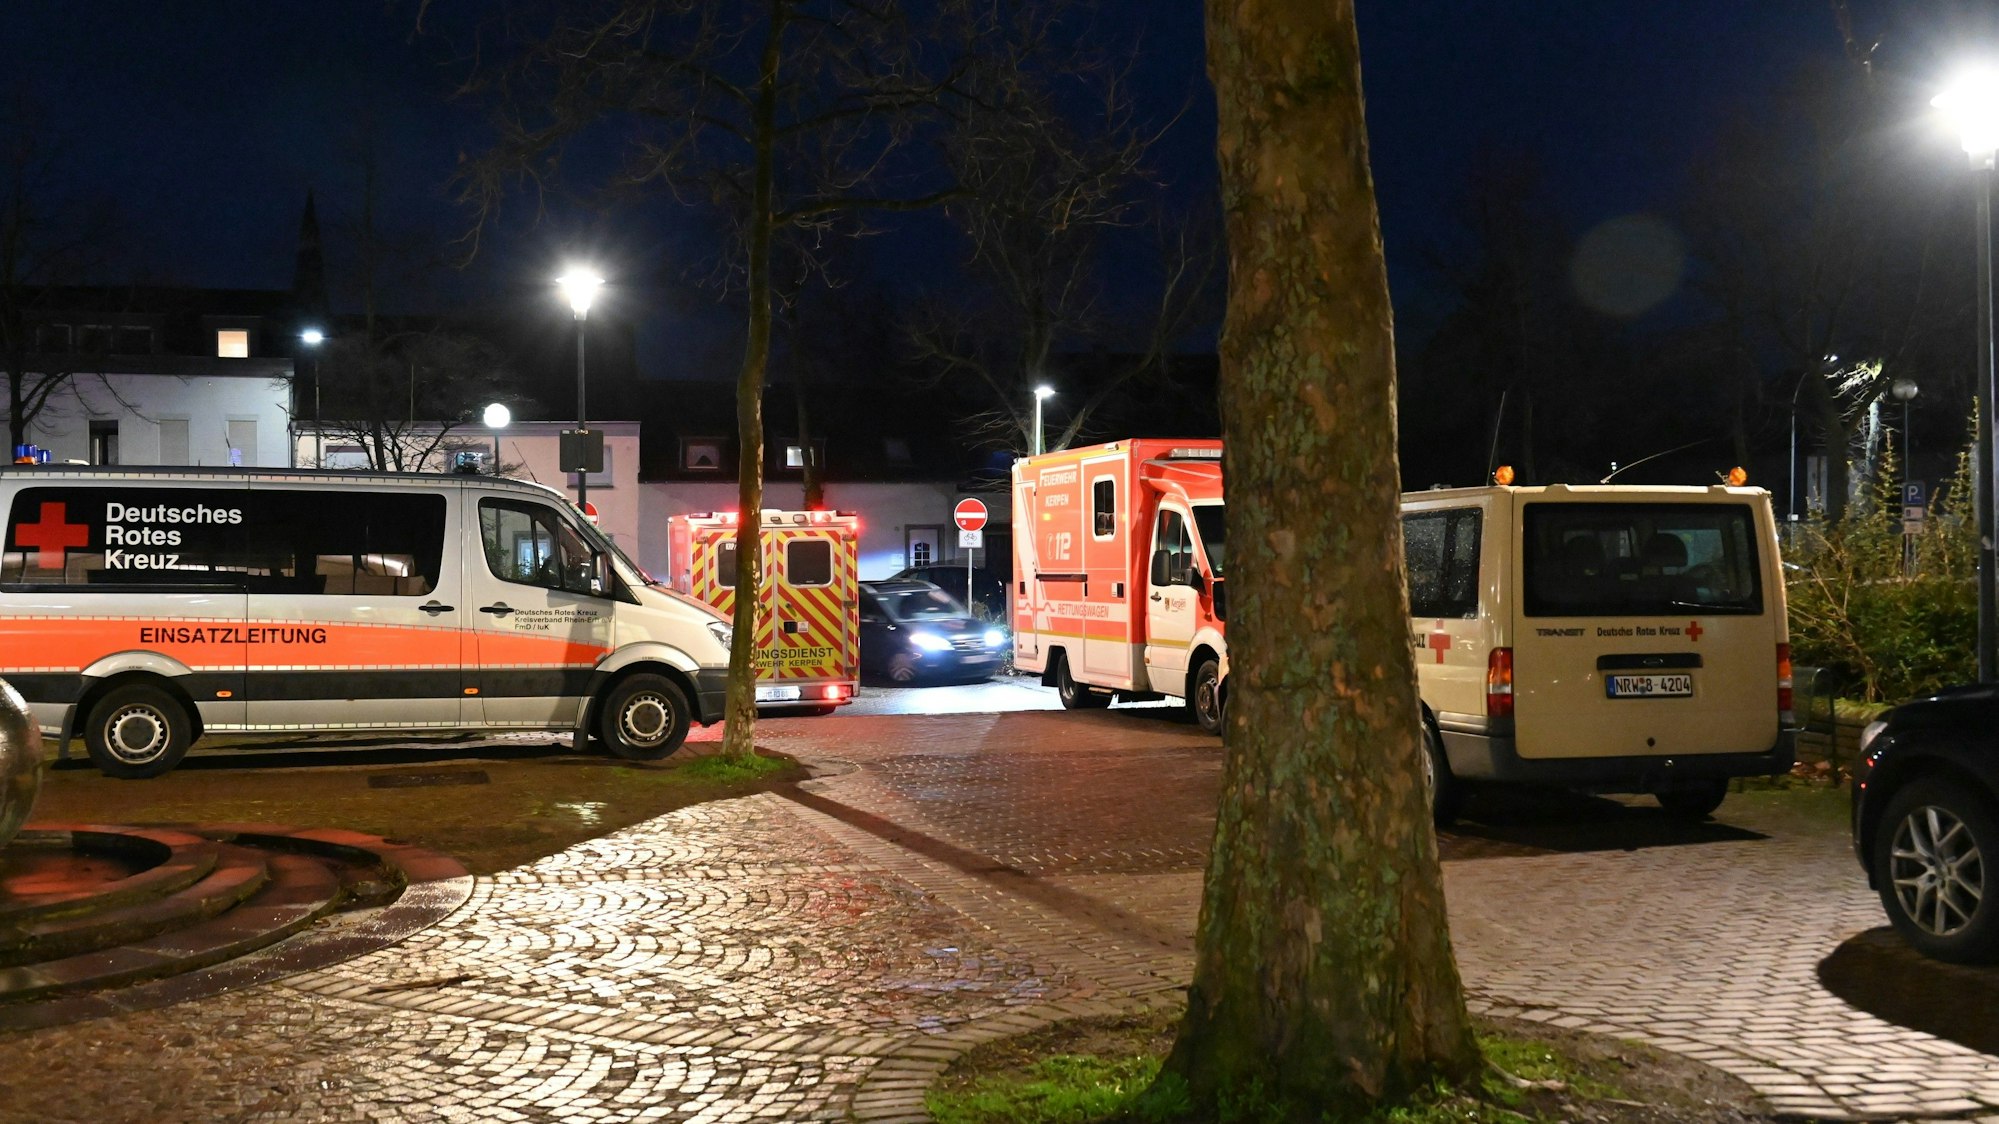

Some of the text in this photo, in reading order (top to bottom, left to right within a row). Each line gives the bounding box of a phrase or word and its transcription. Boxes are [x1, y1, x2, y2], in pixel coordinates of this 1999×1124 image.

[1045, 493, 1069, 507] KERPEN
[106, 502, 243, 525] Deutsches
[105, 525, 182, 546] Rotes
[1055, 531, 1071, 561] 112
[104, 549, 179, 571] Kreuz
[514, 608, 553, 616] Deutsches
[1057, 602, 1109, 618] RETTUNGSWAGEN
[139, 627, 327, 645] EINSATZLEITUNG
[1536, 628, 1586, 637] TRANSIT
[1597, 625, 1681, 637] Deutsches Rotes Kreuz
[789, 659, 823, 667] KERPEN
[1615, 678, 1639, 693] NRW
